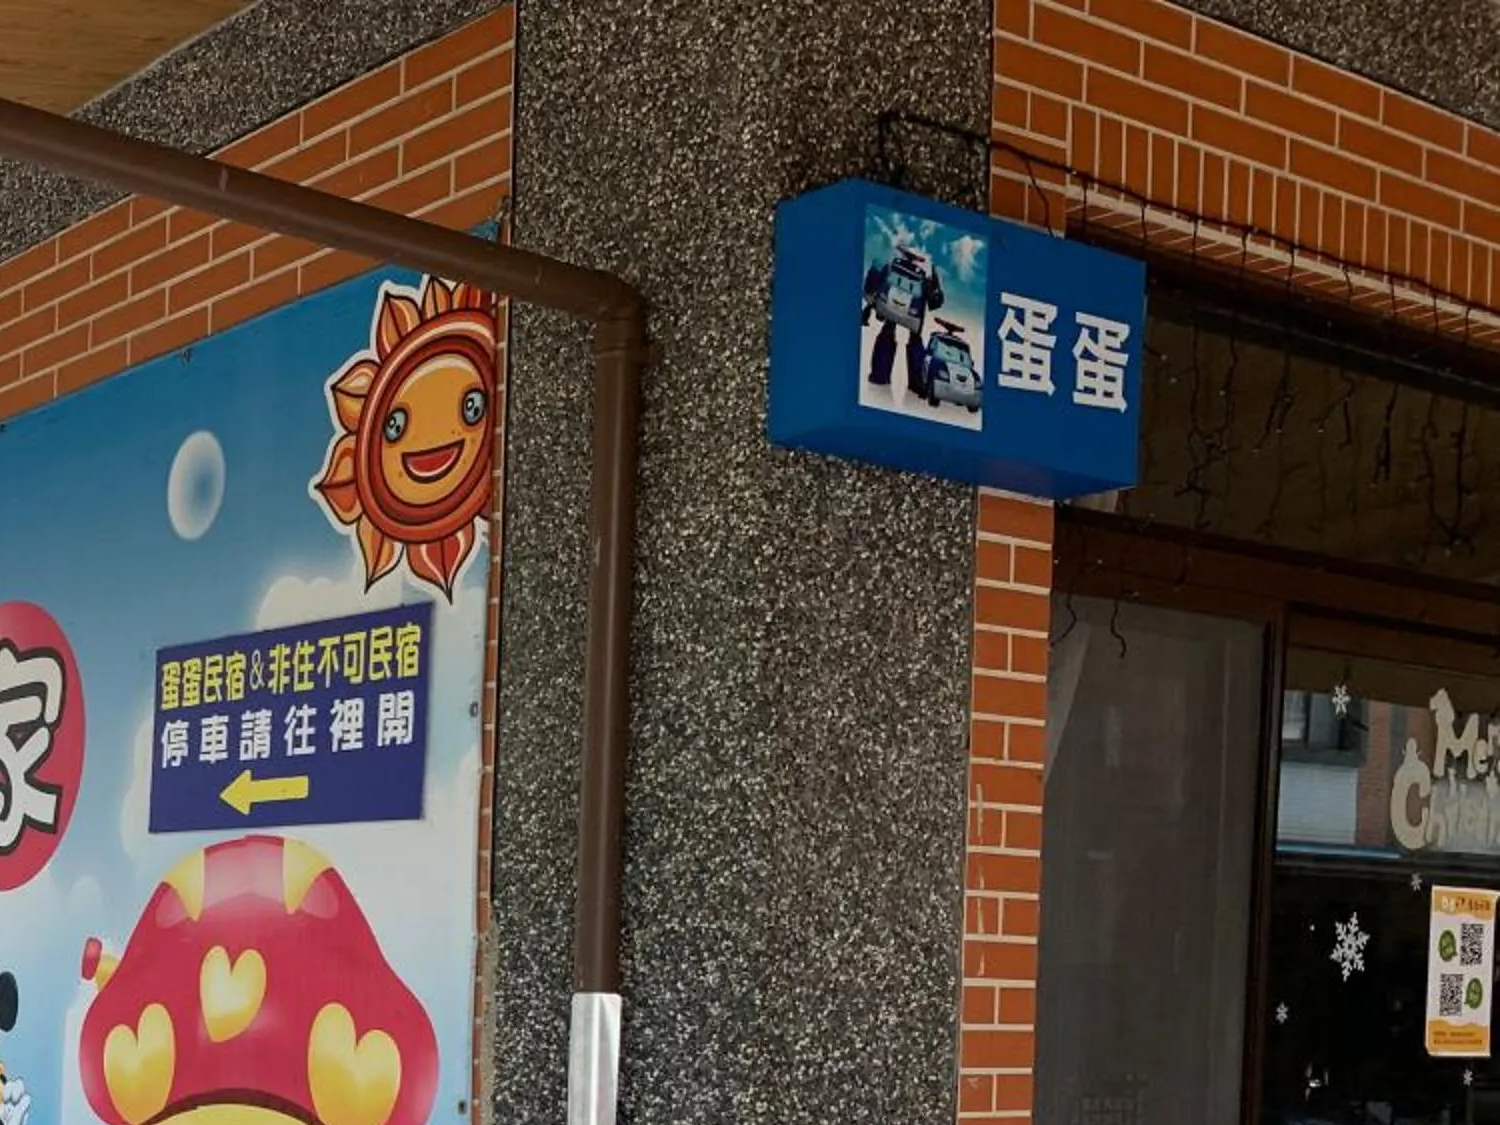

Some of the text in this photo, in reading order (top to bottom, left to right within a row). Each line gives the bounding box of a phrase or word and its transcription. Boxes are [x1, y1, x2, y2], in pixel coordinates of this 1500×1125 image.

[997, 291, 1131, 414] 蛋蛋
[161, 690, 415, 768] 停車請往裡開
